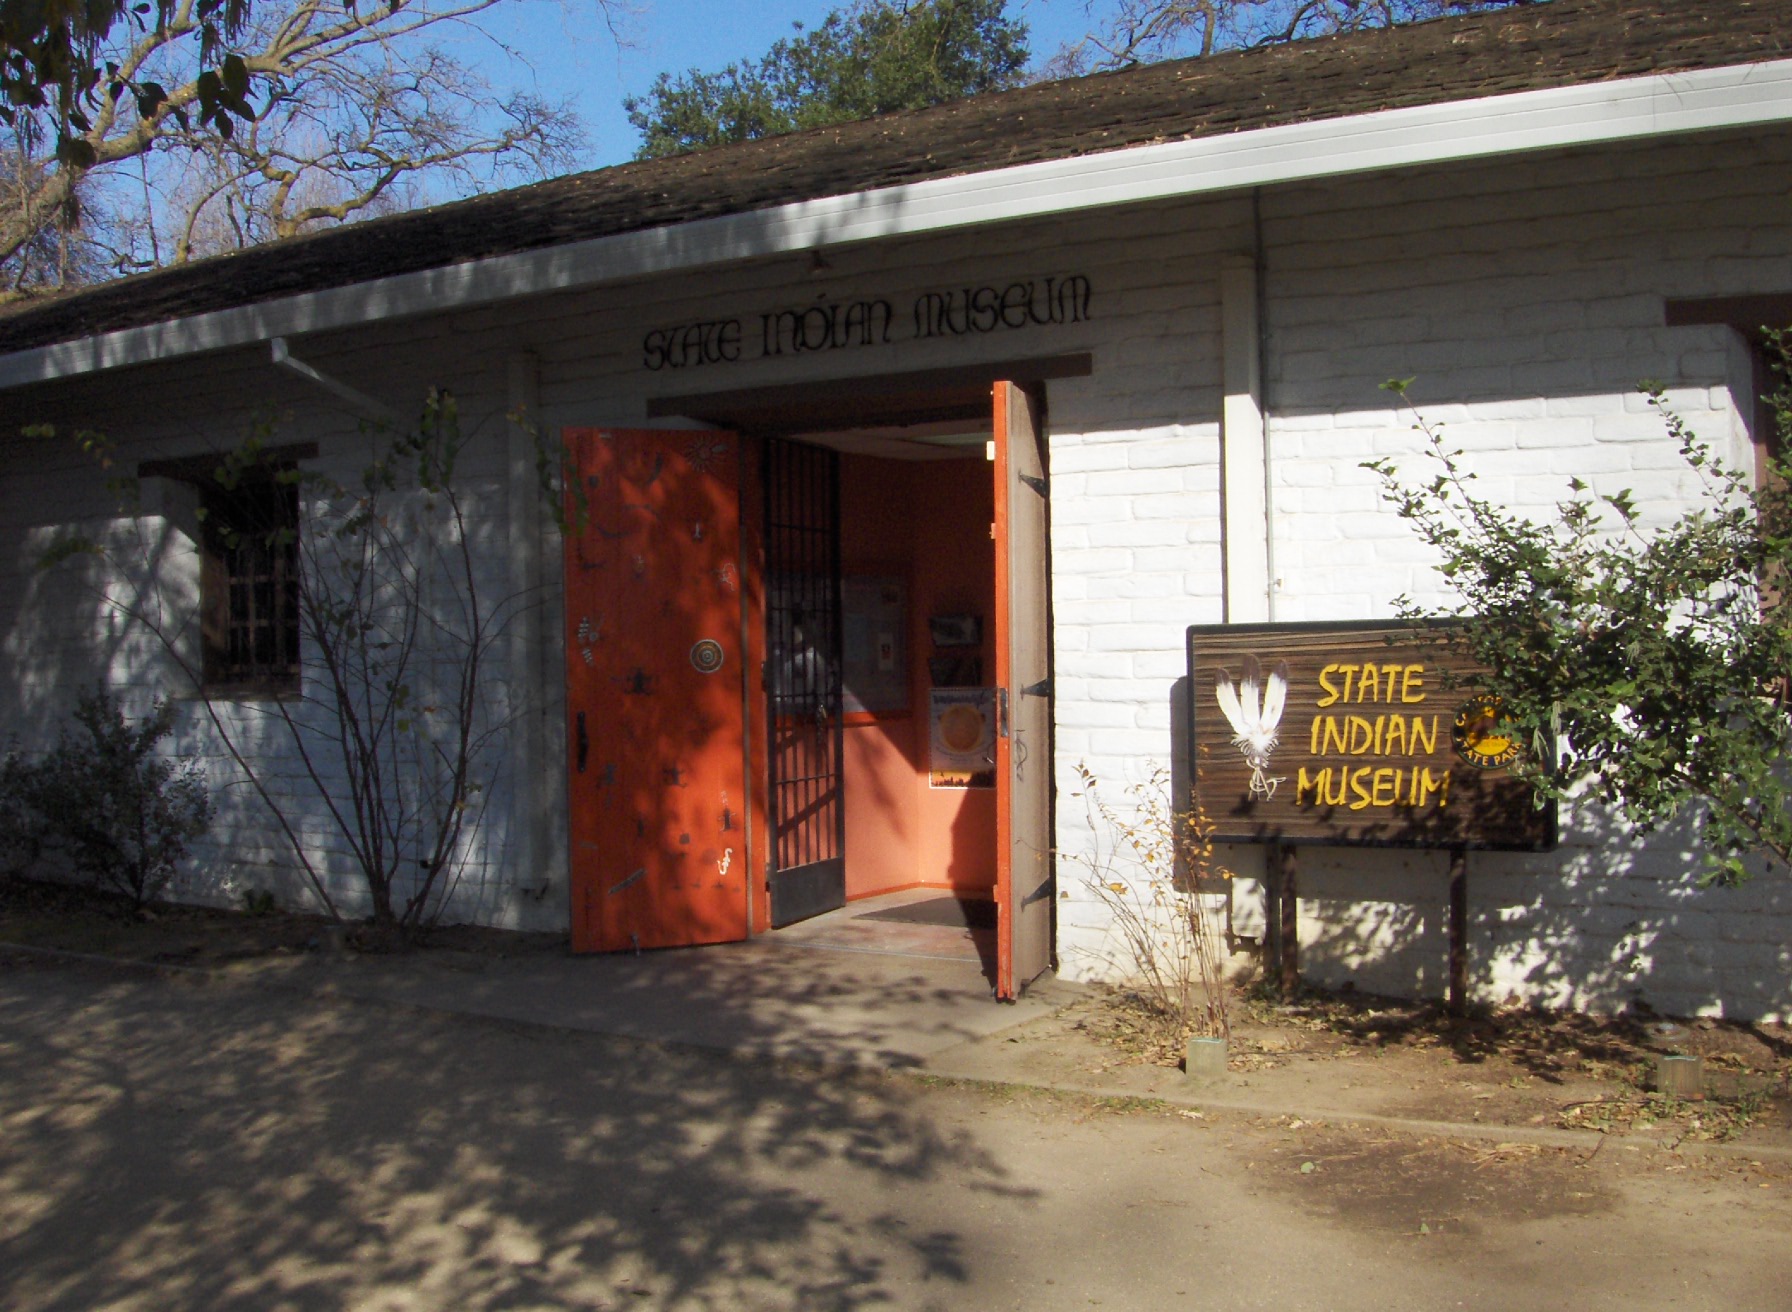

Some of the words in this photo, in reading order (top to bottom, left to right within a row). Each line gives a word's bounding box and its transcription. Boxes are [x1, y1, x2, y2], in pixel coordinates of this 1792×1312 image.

[643, 319, 741, 371] STATE
[760, 295, 892, 357] INDIAN
[912, 273, 1091, 338] MUSEUM
[1317, 662, 1426, 708] STATE
[1310, 714, 1438, 756] INDIAN
[1456, 737, 1488, 766] TATE
[1295, 765, 1450, 810] MUSEUM
